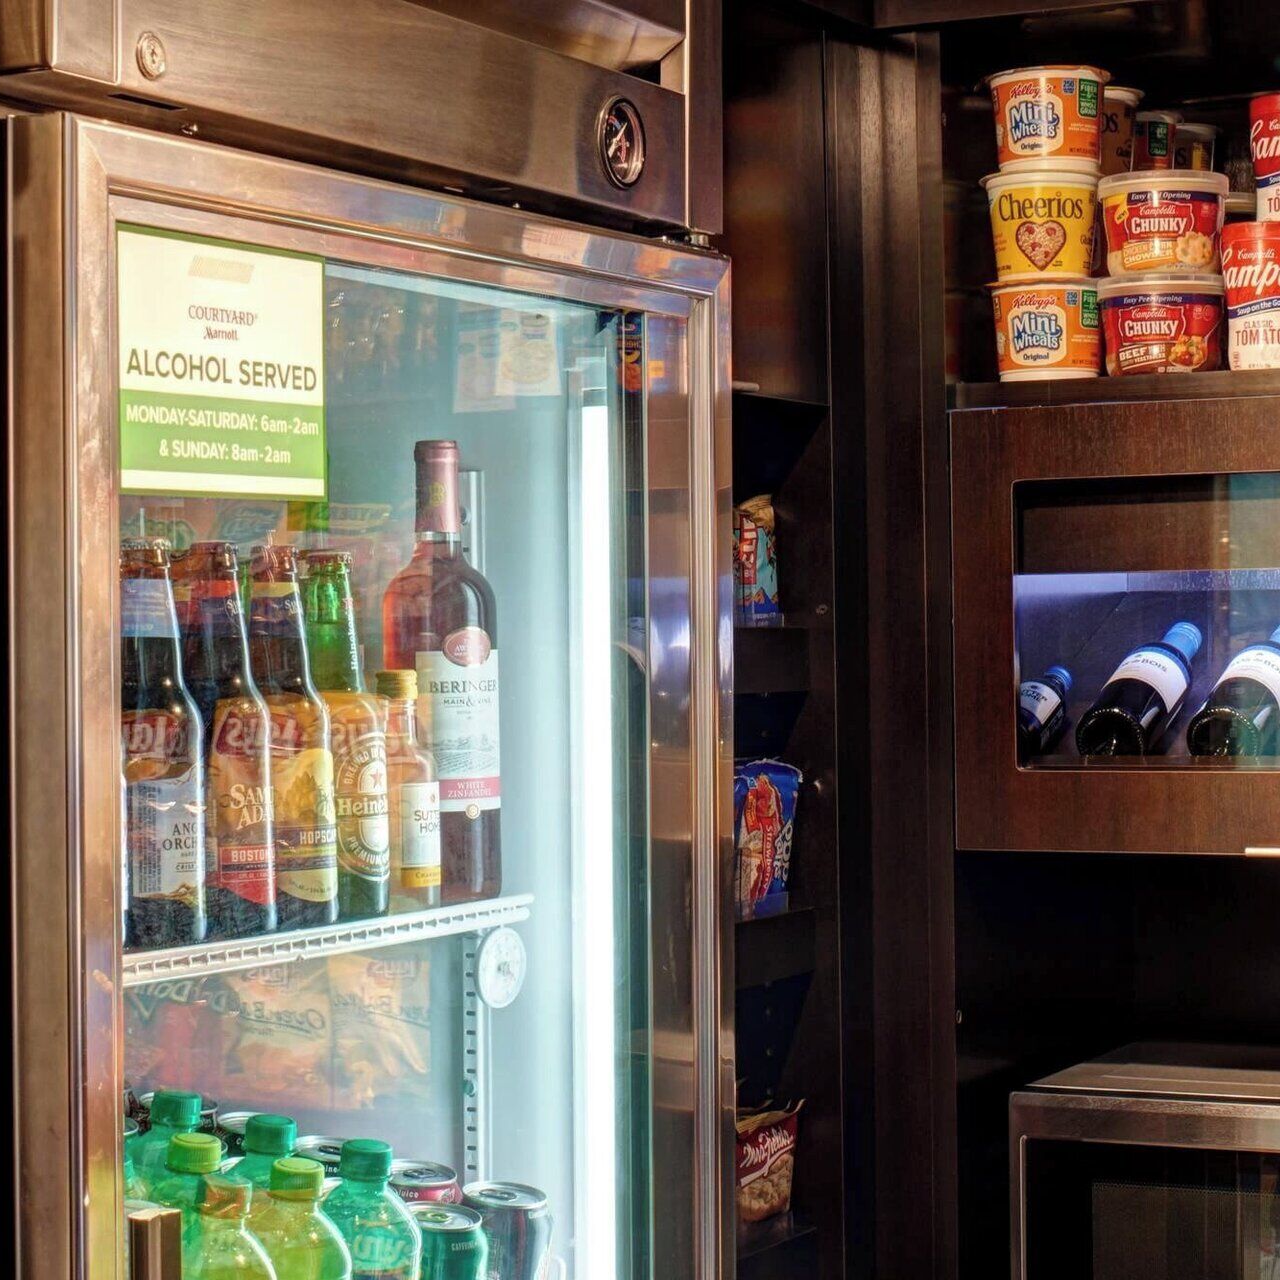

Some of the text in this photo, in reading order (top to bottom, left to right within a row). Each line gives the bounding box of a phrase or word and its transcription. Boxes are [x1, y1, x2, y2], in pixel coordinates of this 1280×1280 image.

[998, 192, 1085, 222] Cheerios
[1131, 217, 1187, 234] CHUNKY
[188, 304, 254, 326] COURTYARD
[1012, 312, 1061, 338] Mini
[1124, 319, 1178, 337] CHUNKY
[1013, 332, 1062, 352] Wheats
[1119, 344, 1148, 361] BEEF
[1023, 352, 1050, 361] Original
[126, 348, 317, 391] ALCOHOL SERVED
[125, 404, 319, 436] MONDAY-SATURDAY: 6am-2am
[159, 440, 291, 464] & SUNDAY: 8am-2am
[429, 679, 498, 694] BERINGER
